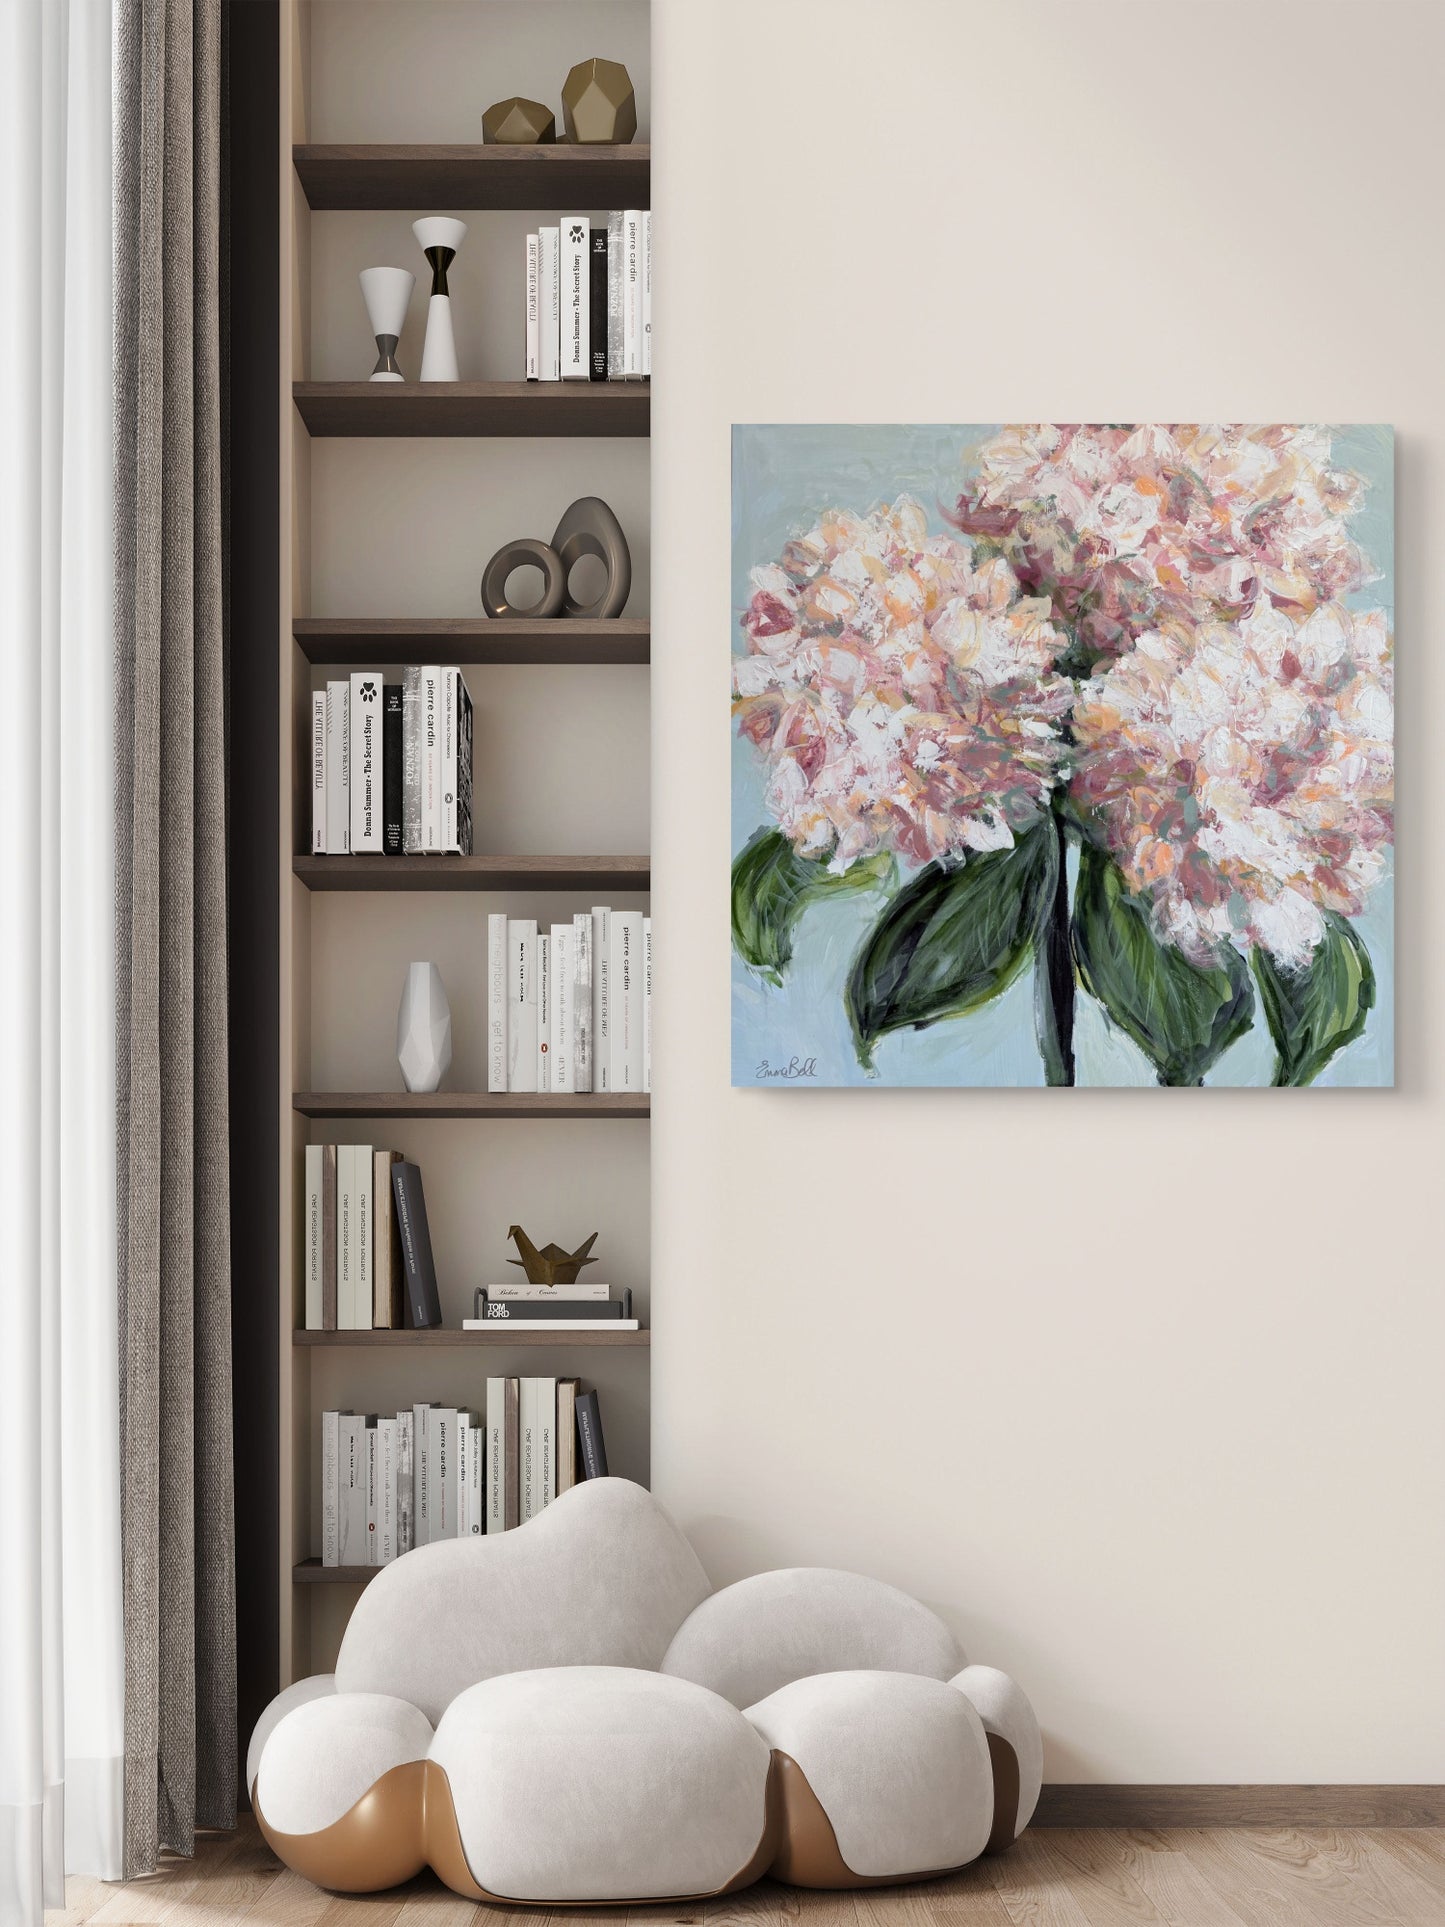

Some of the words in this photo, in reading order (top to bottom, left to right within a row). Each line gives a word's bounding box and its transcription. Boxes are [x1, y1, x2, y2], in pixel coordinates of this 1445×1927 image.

[629, 222, 637, 250] pierre
[573, 254, 582, 271] Story
[426, 680, 435, 711] pierre
[364, 715, 374, 734] Story
[427, 714, 435, 747] cardin
[364, 735, 372, 758] Secret
[364, 760, 372, 774] The
[364, 779, 372, 811] Summer
[364, 812, 372, 837] Donna
[623, 927, 631, 956] pierre
[492, 944, 504, 1004] neighbours
[491, 1021, 502, 1037] get
[494, 1042, 502, 1053] to
[494, 1056, 504, 1084] know
[488, 1303, 506, 1311] TOM
[488, 1310, 510, 1318] FORD
[325, 1505, 335, 1519] get
[327, 1523, 335, 1532] to
[327, 1535, 336, 1559] know
